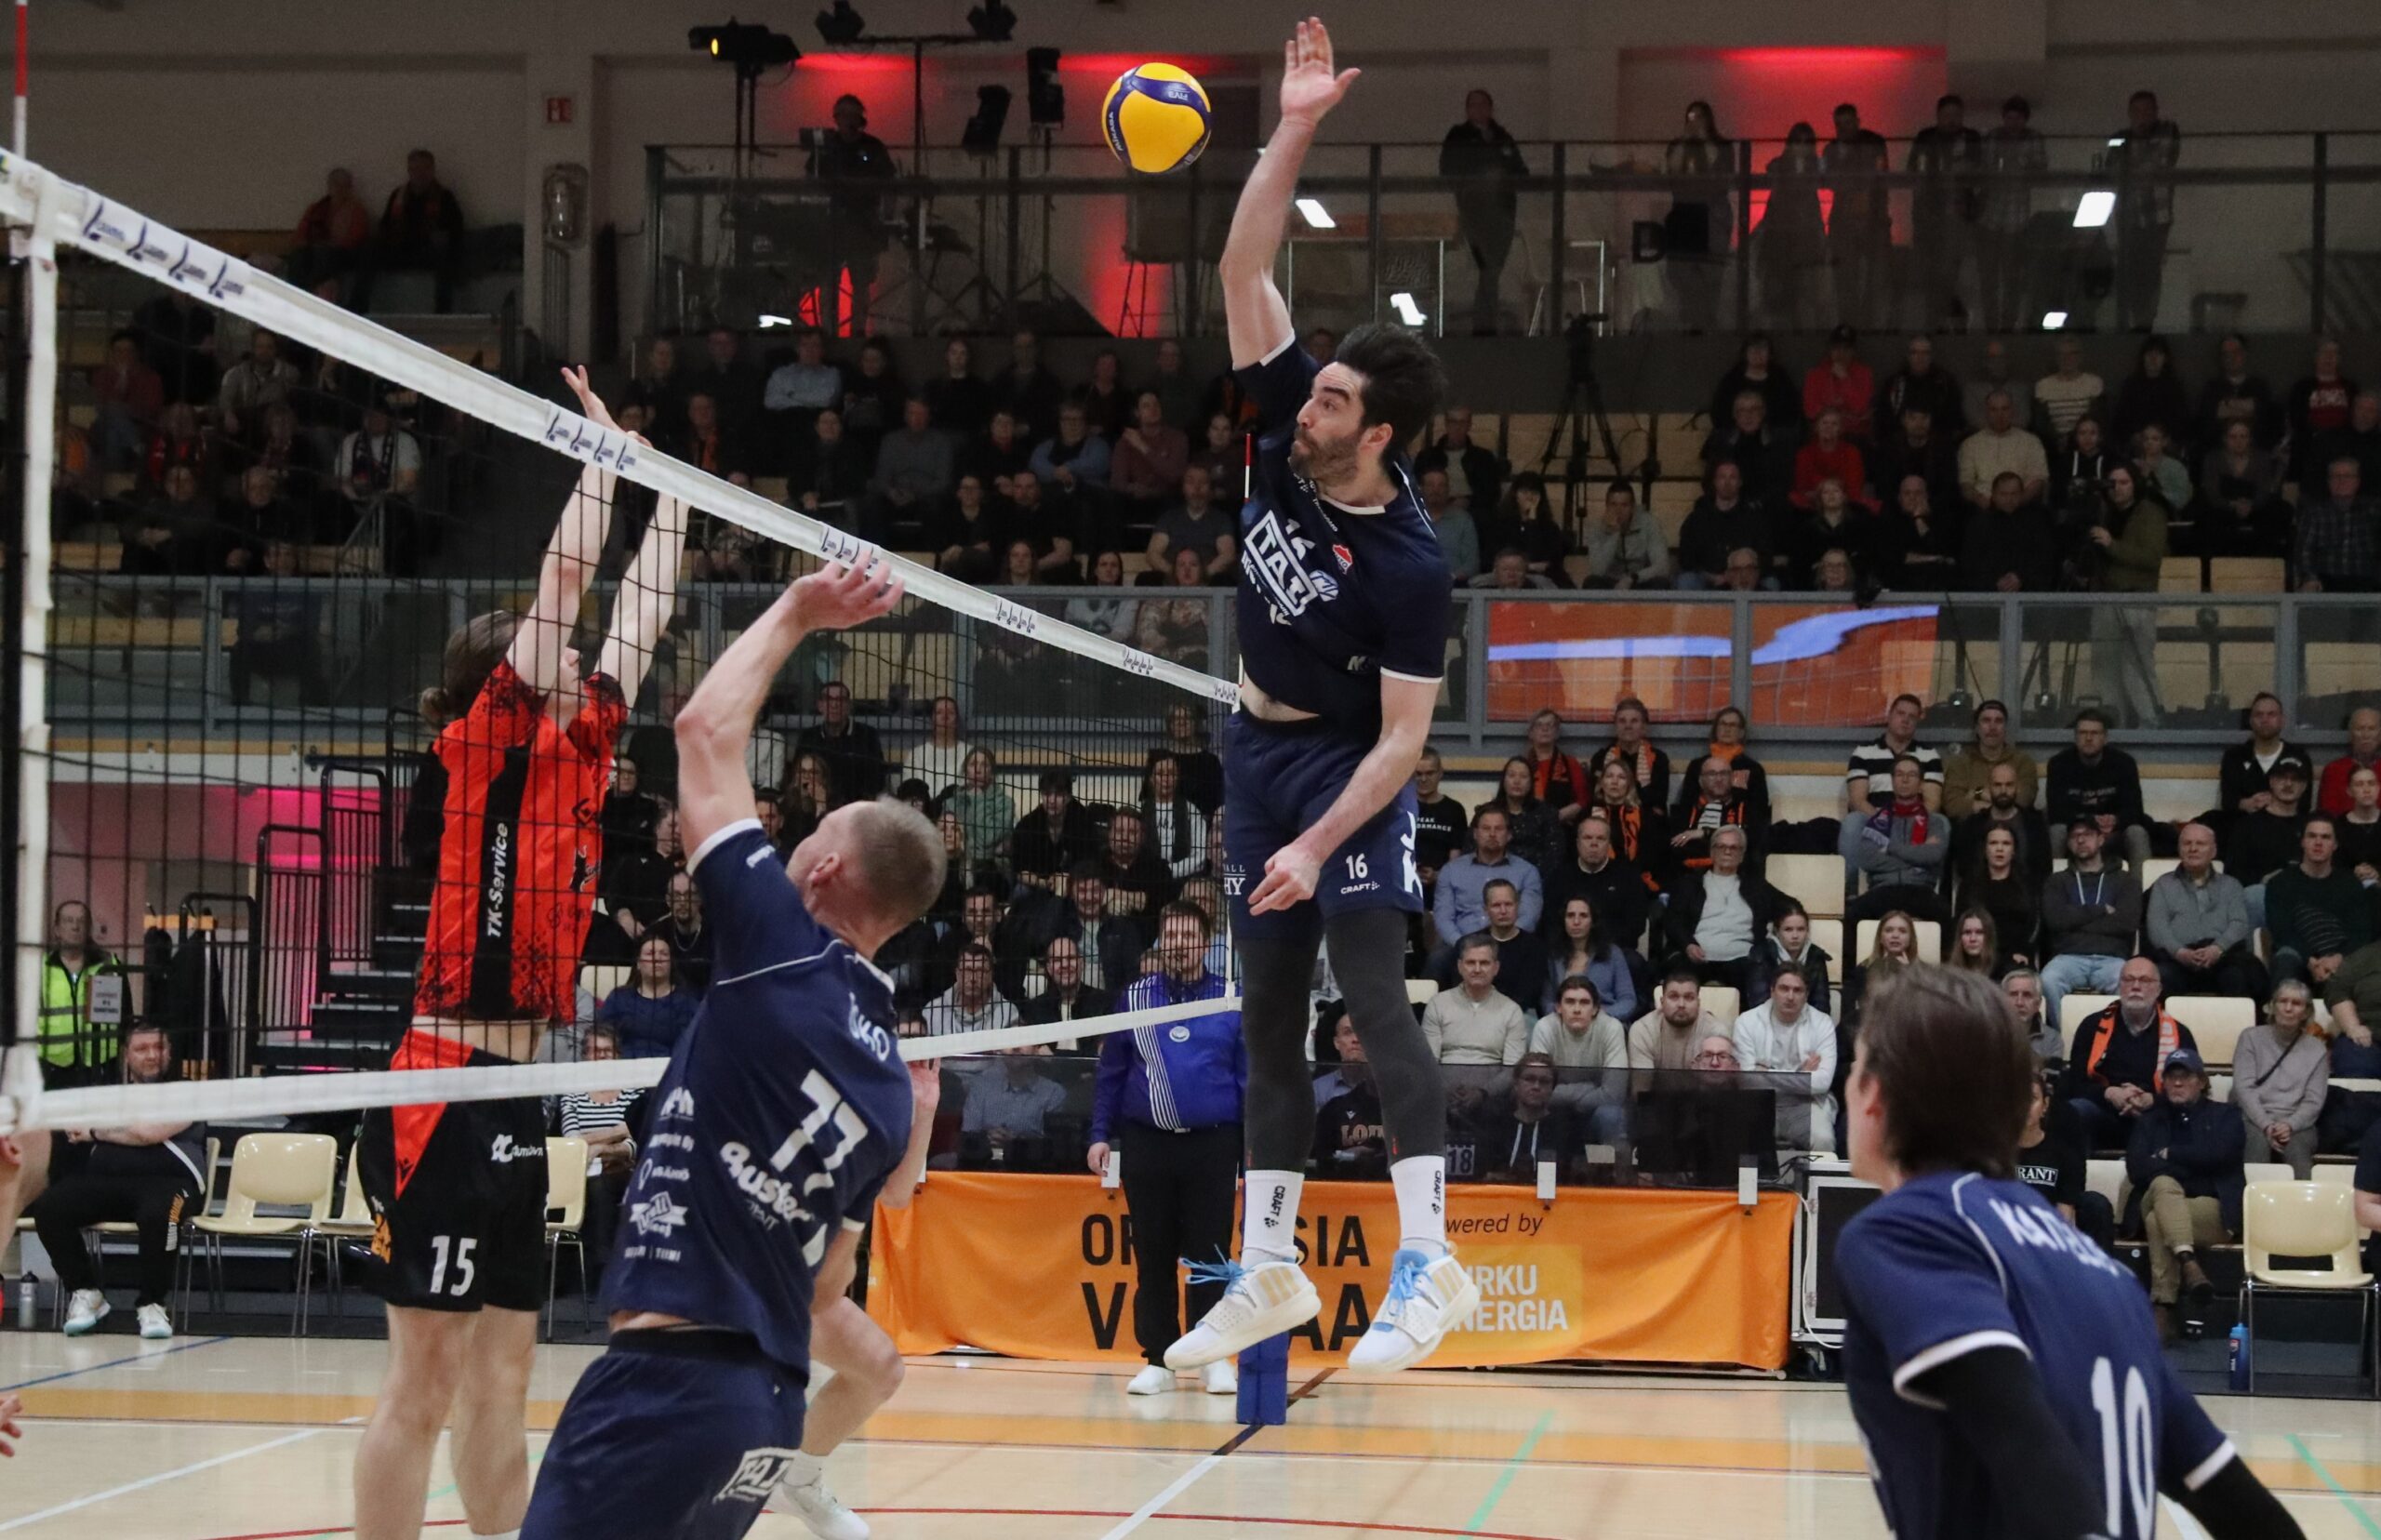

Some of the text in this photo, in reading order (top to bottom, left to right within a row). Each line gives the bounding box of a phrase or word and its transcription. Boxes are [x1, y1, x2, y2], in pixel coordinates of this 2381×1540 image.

[1167, 90, 1189, 100] FIVB
[1108, 111, 1124, 152] MIKASA
[487, 822, 508, 938] TK-Service
[1345, 853, 1368, 880] 16
[1340, 883, 1371, 895] CRAFT
[1447, 1148, 1473, 1174] 18
[1270, 1185, 1285, 1216] CRAFT
[1432, 1170, 1442, 1201] CRAFT
[1518, 1213, 1544, 1237] by
[431, 1235, 478, 1296] 15
[2091, 1355, 2156, 1540] 10
